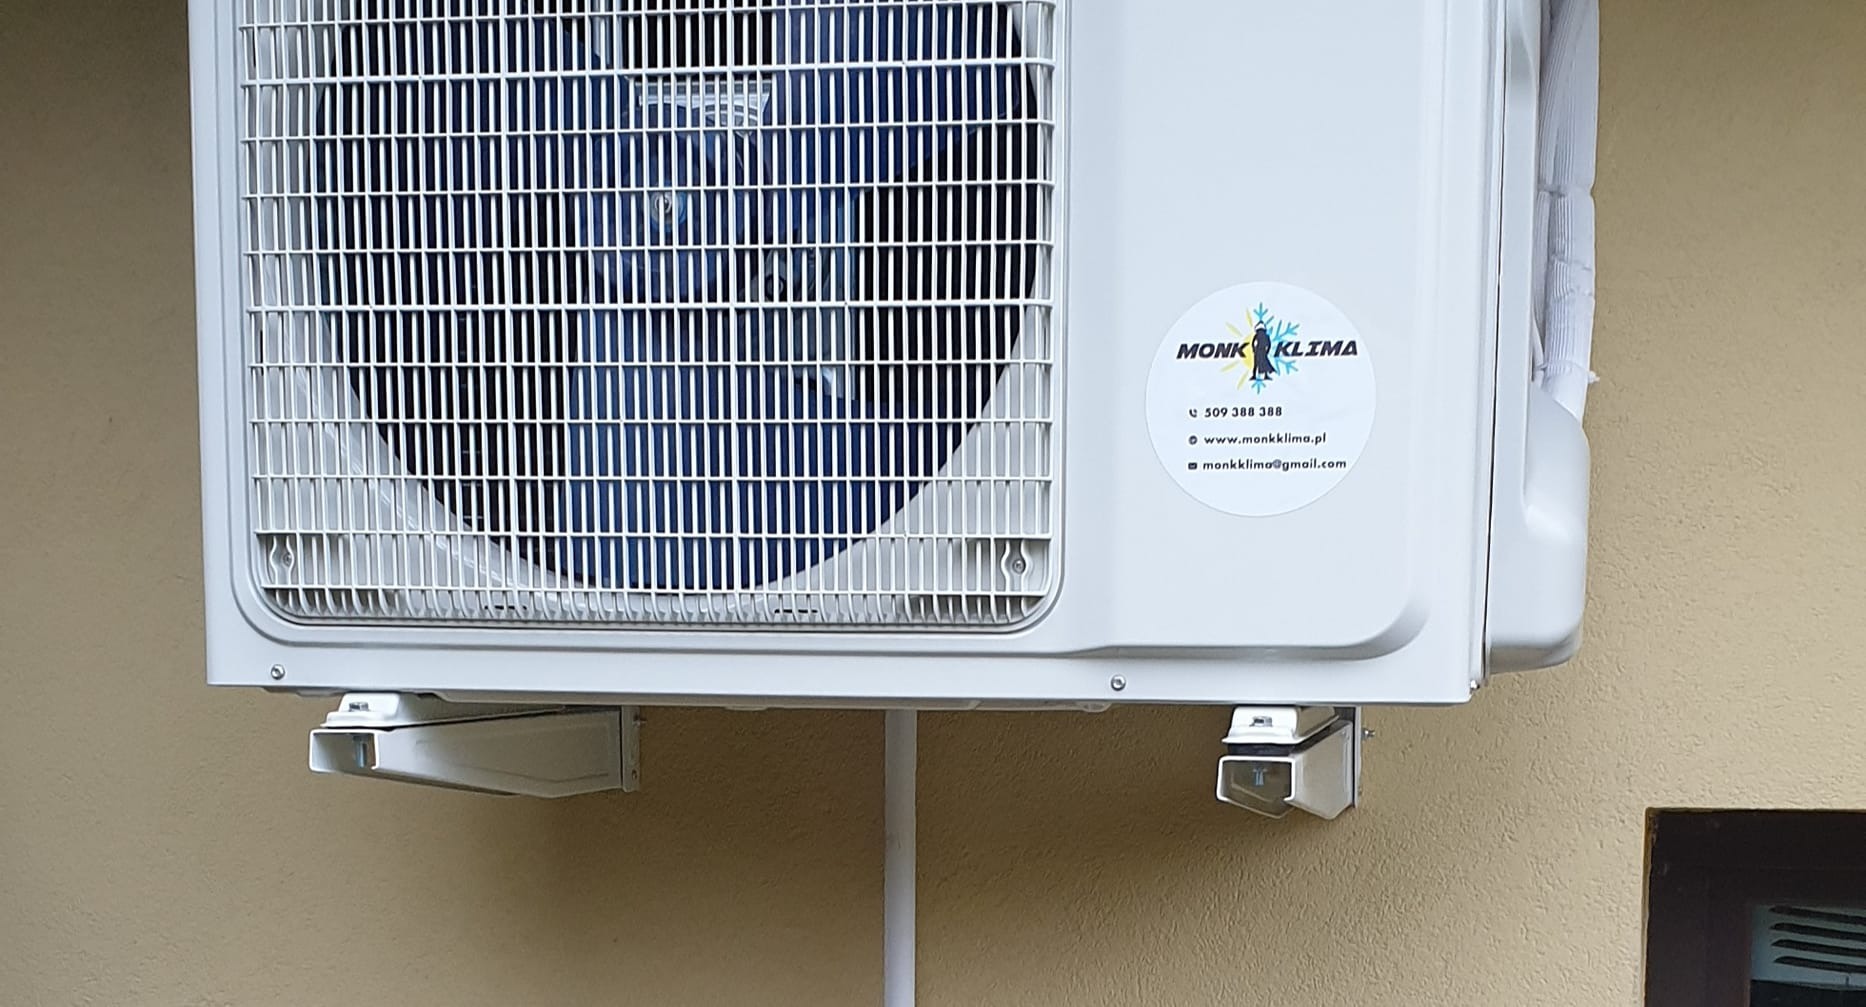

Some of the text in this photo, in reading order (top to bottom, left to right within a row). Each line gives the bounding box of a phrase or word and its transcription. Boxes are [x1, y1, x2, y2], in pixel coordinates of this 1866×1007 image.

[1176, 340, 1358, 359] MONK KLIMA
[1204, 406, 1282, 418] 509 388 388
[1204, 432, 1327, 445] www.monkklima.pl
[1203, 458, 1347, 471] monkklima@gmail.com
